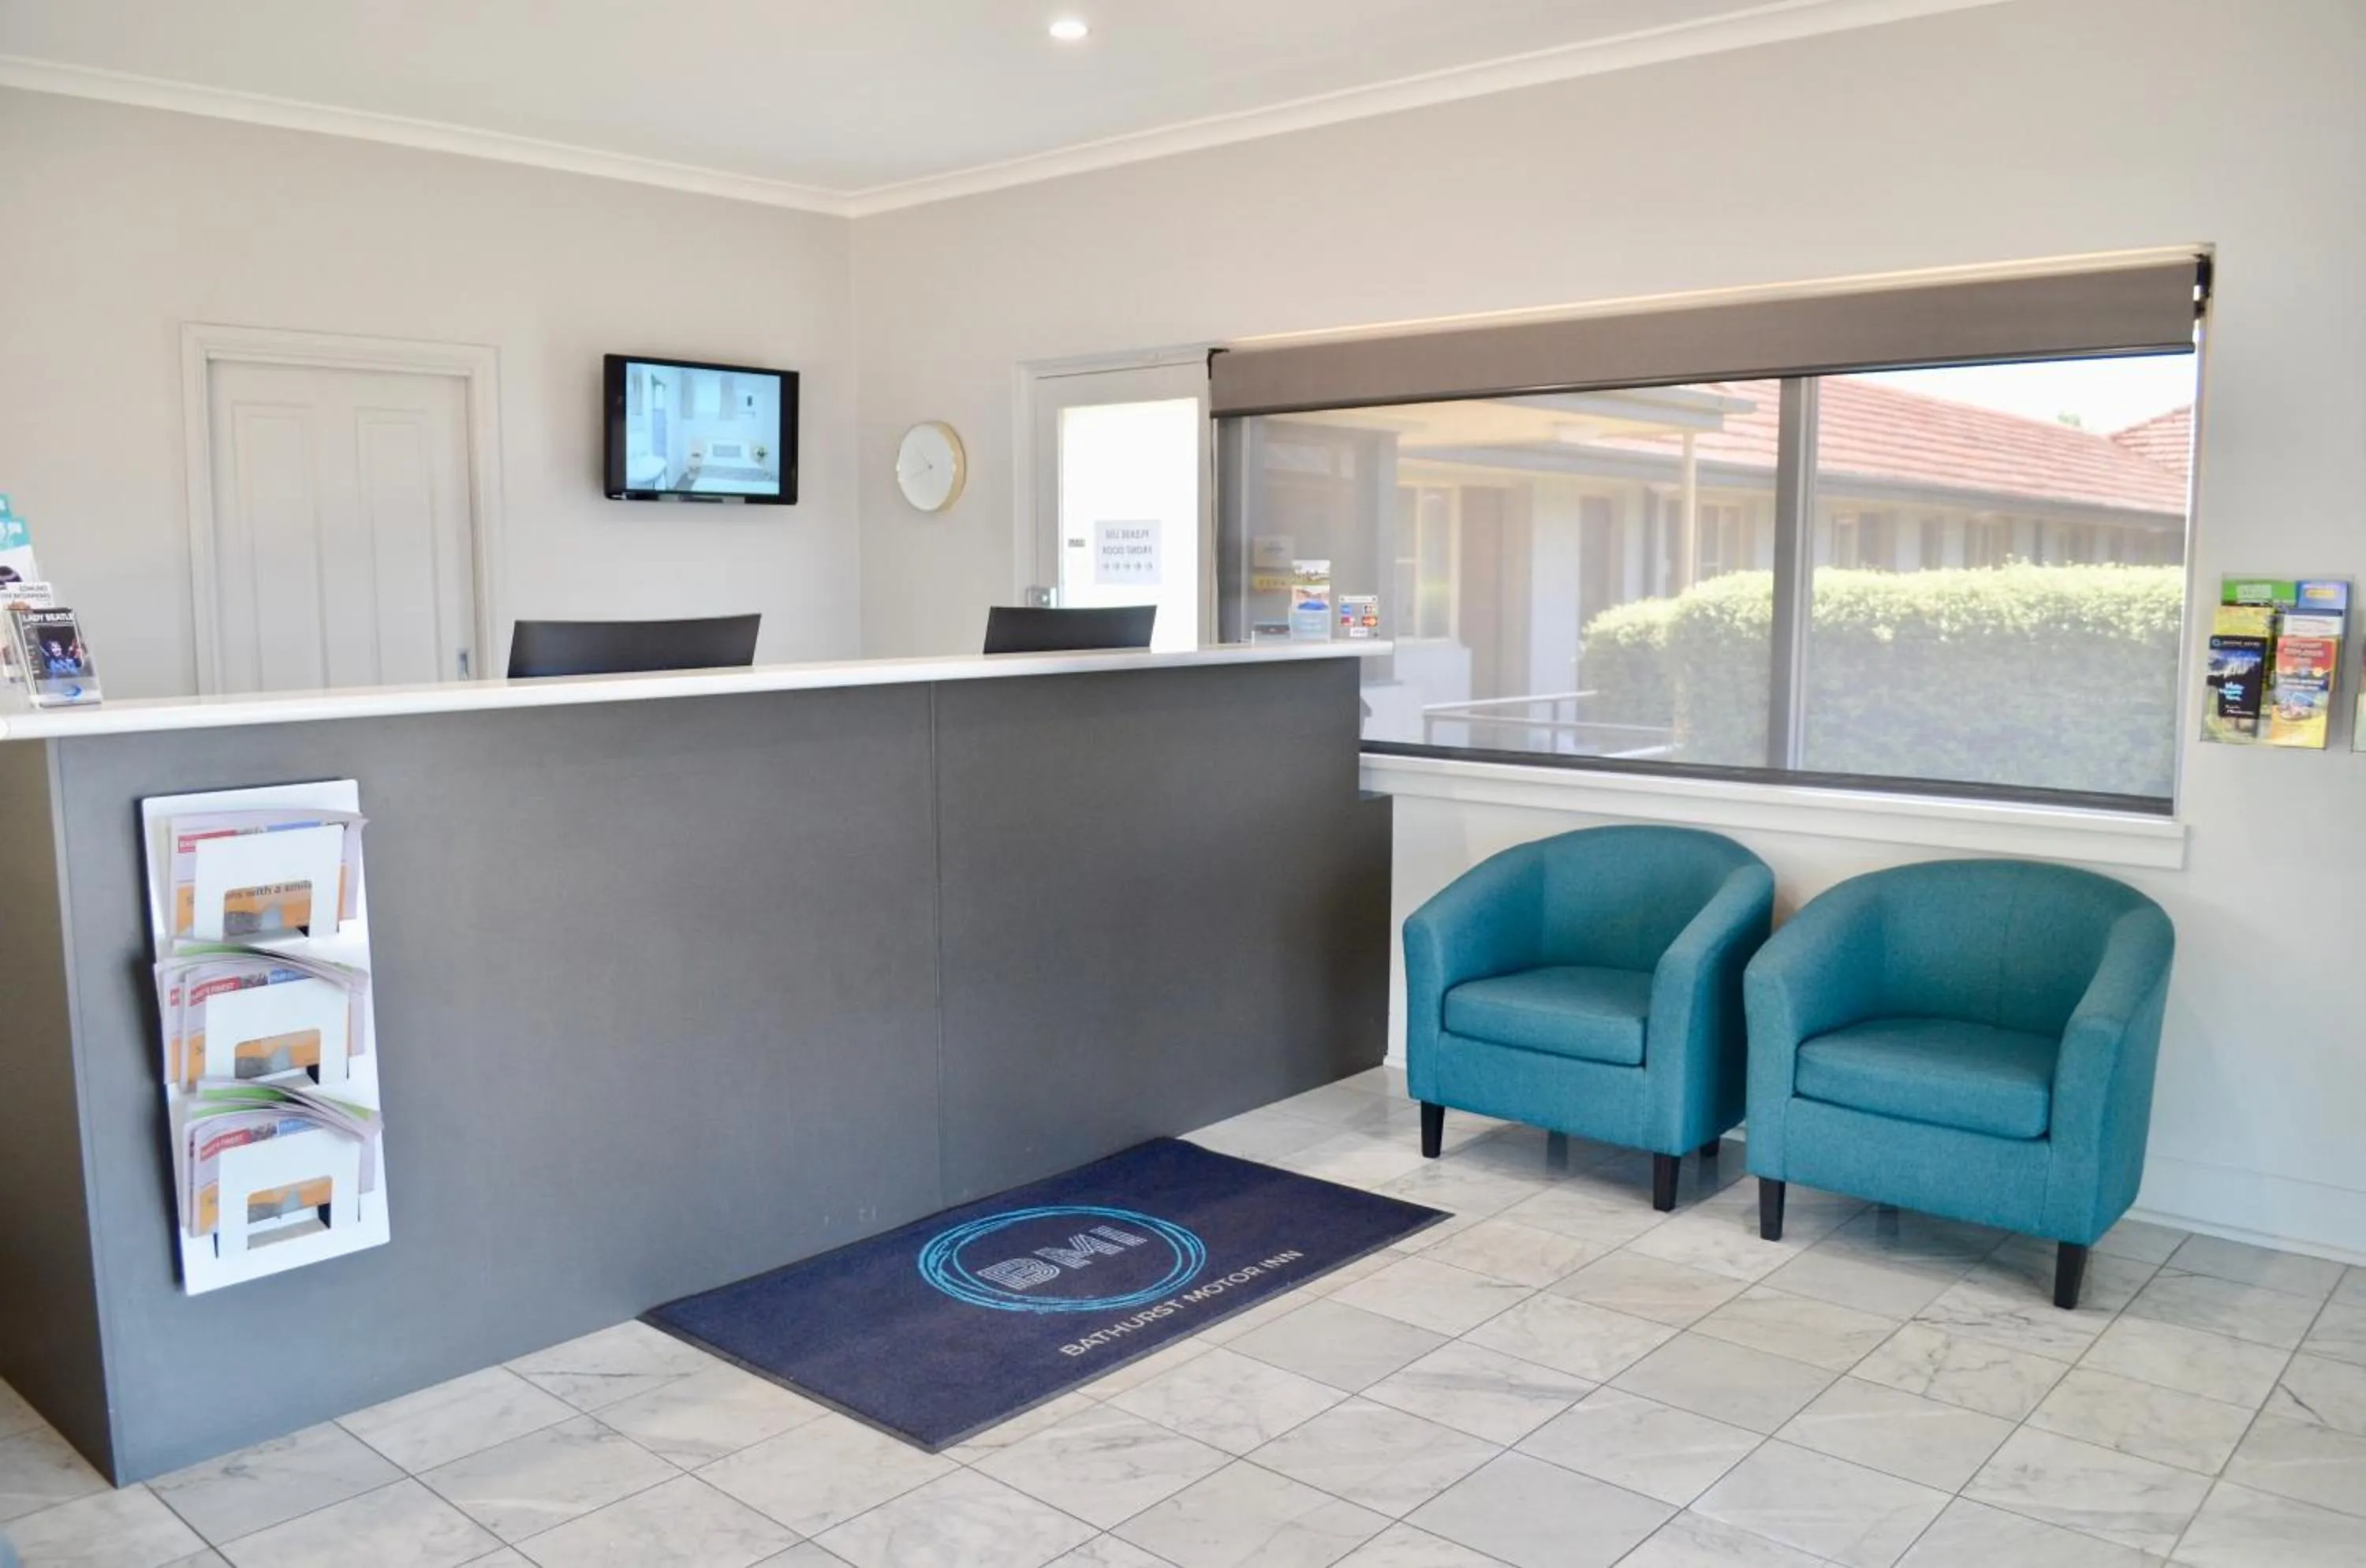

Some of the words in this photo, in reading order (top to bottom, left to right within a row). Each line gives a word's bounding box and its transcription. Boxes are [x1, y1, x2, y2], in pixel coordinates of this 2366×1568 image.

[976, 1225, 1148, 1292] BMI
[1058, 1297, 1186, 1358] BATHURST
[1184, 1264, 1262, 1305] MOTOR
[1261, 1249, 1304, 1273] INN
